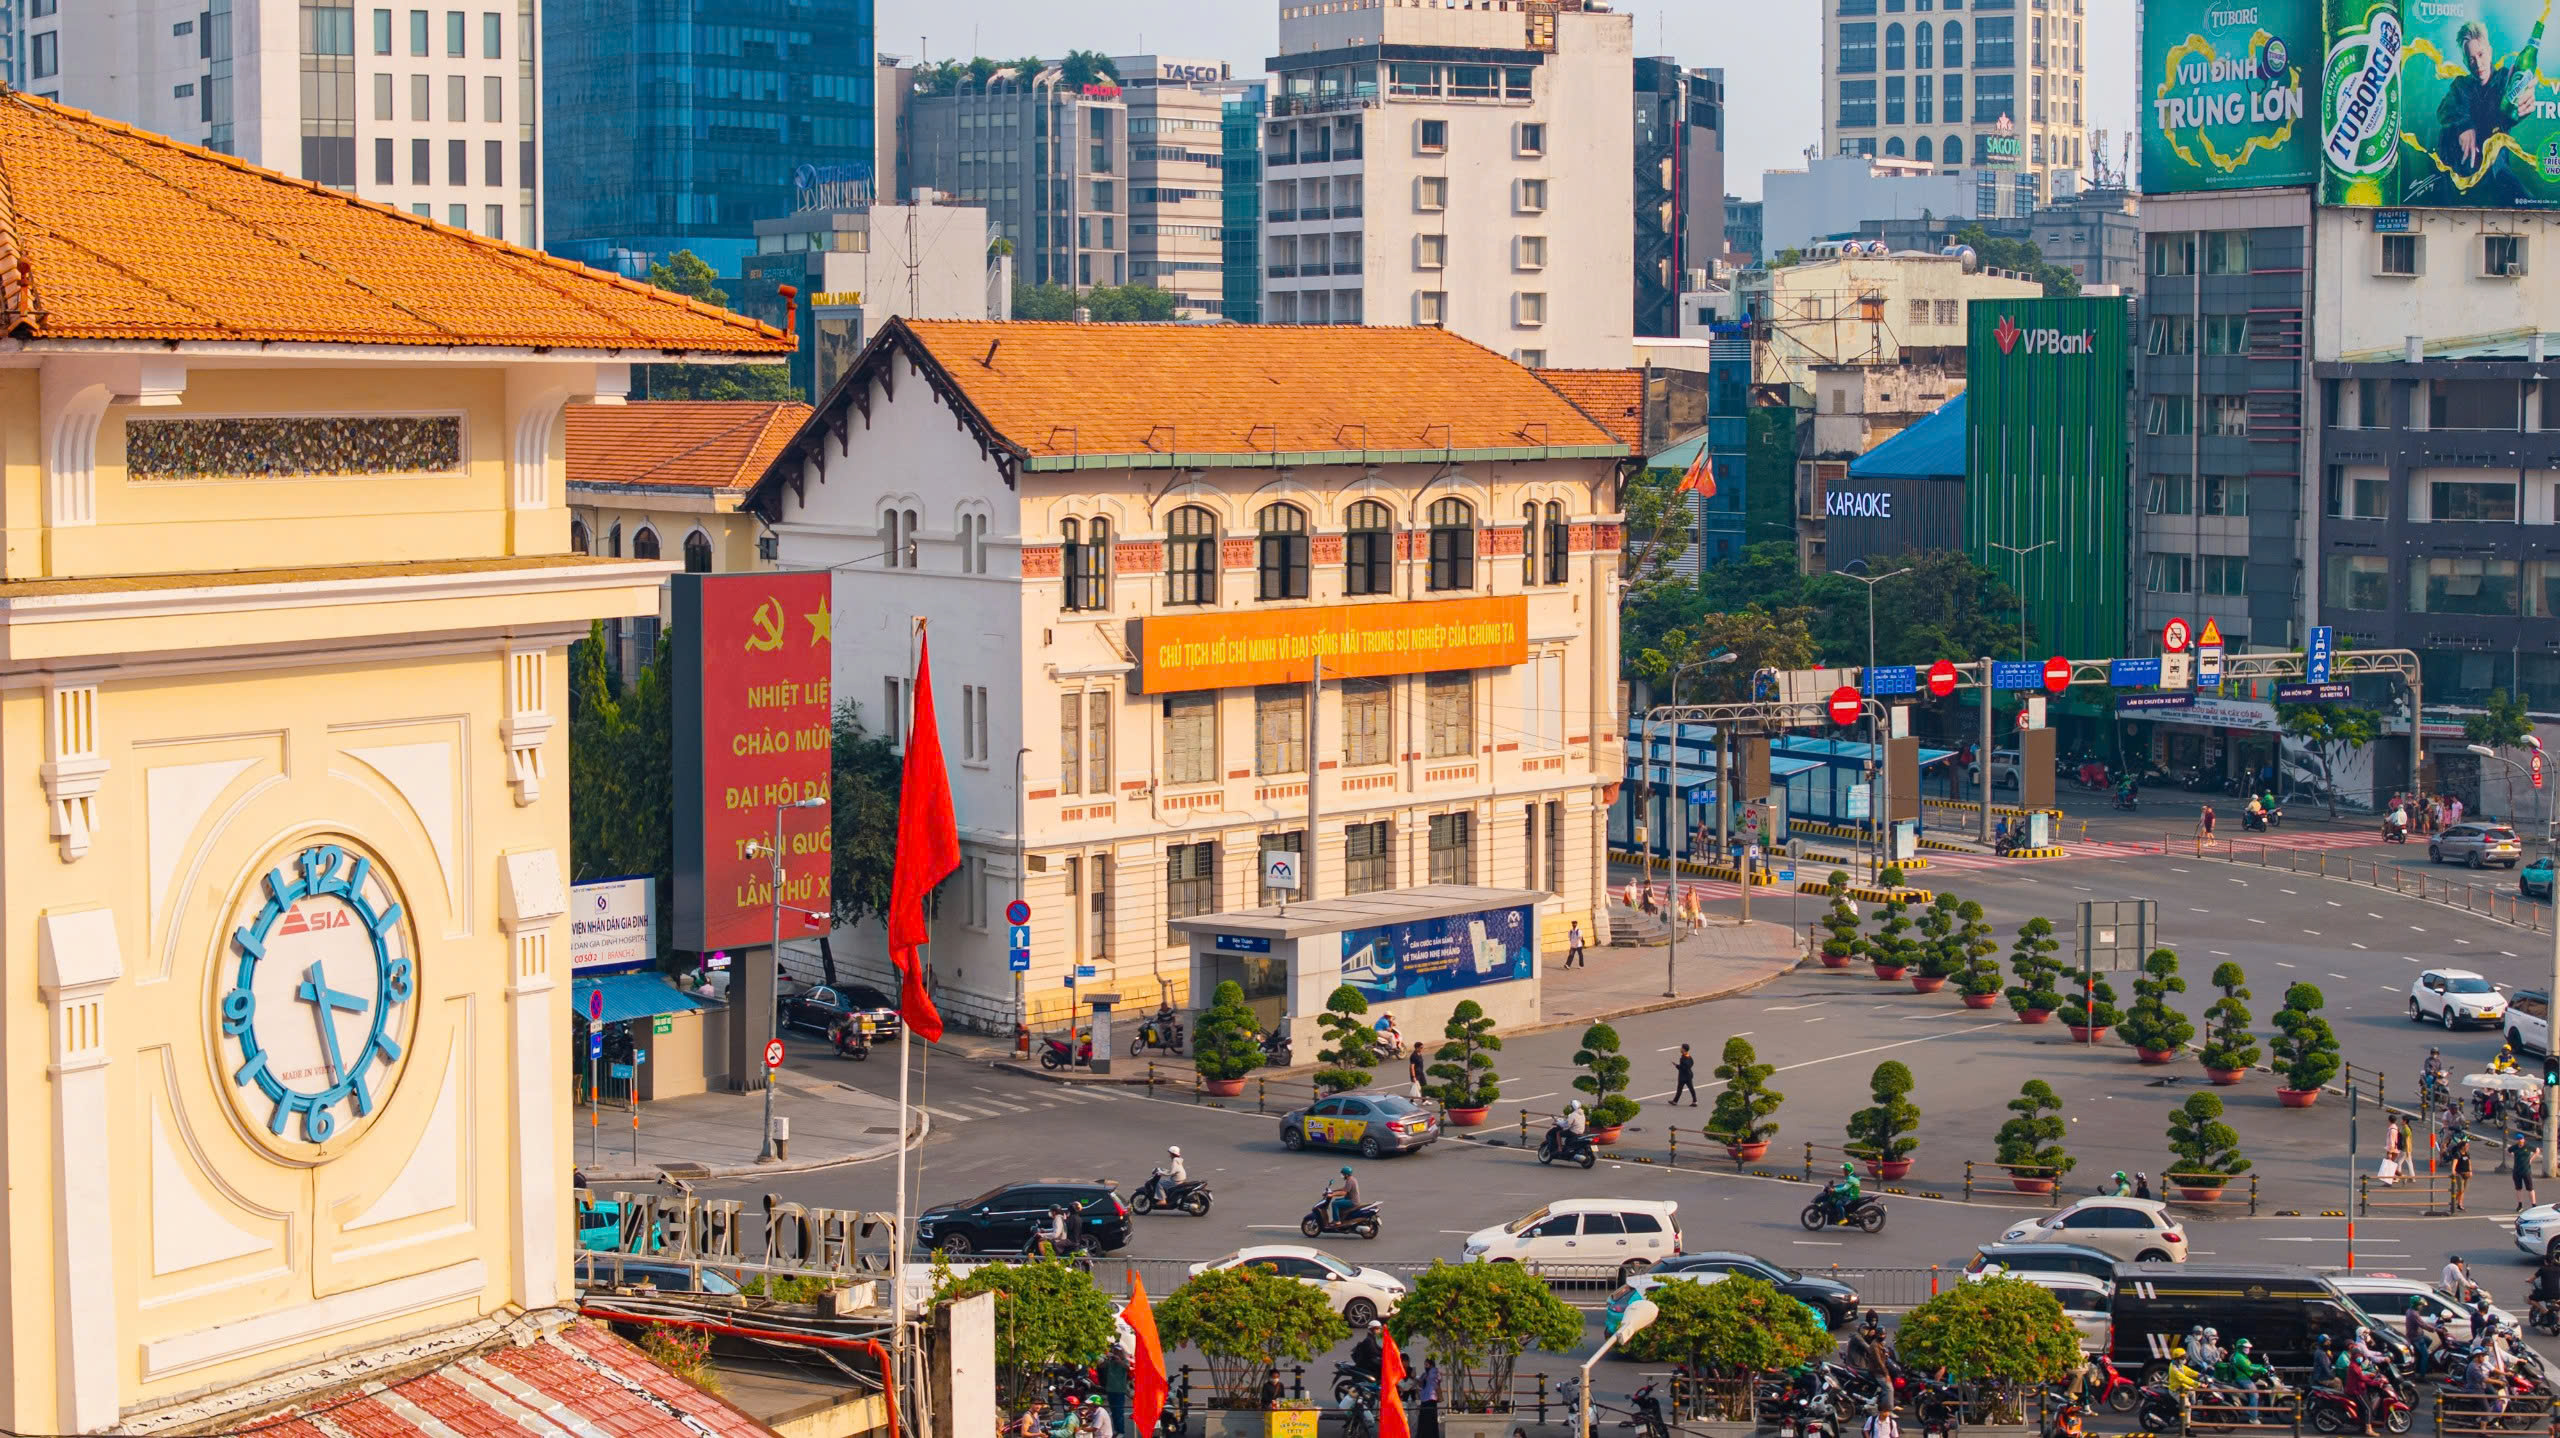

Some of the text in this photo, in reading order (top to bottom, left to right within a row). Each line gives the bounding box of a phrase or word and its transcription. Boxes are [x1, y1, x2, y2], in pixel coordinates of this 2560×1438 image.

[2212, 8, 2258, 28] TUBORG
[2420, 2, 2464, 17] TUBORG
[1164, 64, 1218, 82] TASCO
[2177, 52, 2258, 86] VUI ĐỈNH
[2325, 53, 2356, 120] COPENHAGEN
[2154, 80, 2303, 129] TRÚNG LỚN
[2330, 47, 2393, 162] TUBORG
[2380, 110, 2396, 148] GREEN
[1986, 136, 2022, 155] SAGOTA
[2550, 144, 2557, 156] 3
[832, 293, 838, 304] A
[839, 292, 861, 304] BANK
[2023, 328, 2094, 354] VPBank
[1826, 491, 1891, 518] KARAOKE
[1160, 620, 1515, 671] CHỦ TỊCH HỒ CHÍ MINH VĨ ĐẠI SỐNG MÃI TRONG SỰ NGHIỆP CỦA CHÚNG TA
[748, 679, 800, 712] NHIỆT
[732, 726, 790, 756] CHÀO
[726, 786, 759, 814] ĐẠI
[301, 845, 345, 895] 12
[738, 873, 772, 907] LẦN
[587, 918, 606, 933] NHÂN
[607, 918, 620, 931] DÂN
[621, 918, 632, 929] GIA
[632, 914, 648, 932] ĐỊNH
[574, 935, 648, 950] DAN GIA DINH HOSPITAL
[608, 950, 630, 960] BRANCH
[388, 958, 412, 1003] 3
[222, 988, 256, 1035] 9
[282, 1070, 303, 1080] MADE
[304, 1068, 312, 1077] IN
[306, 1098, 336, 1143] 6
